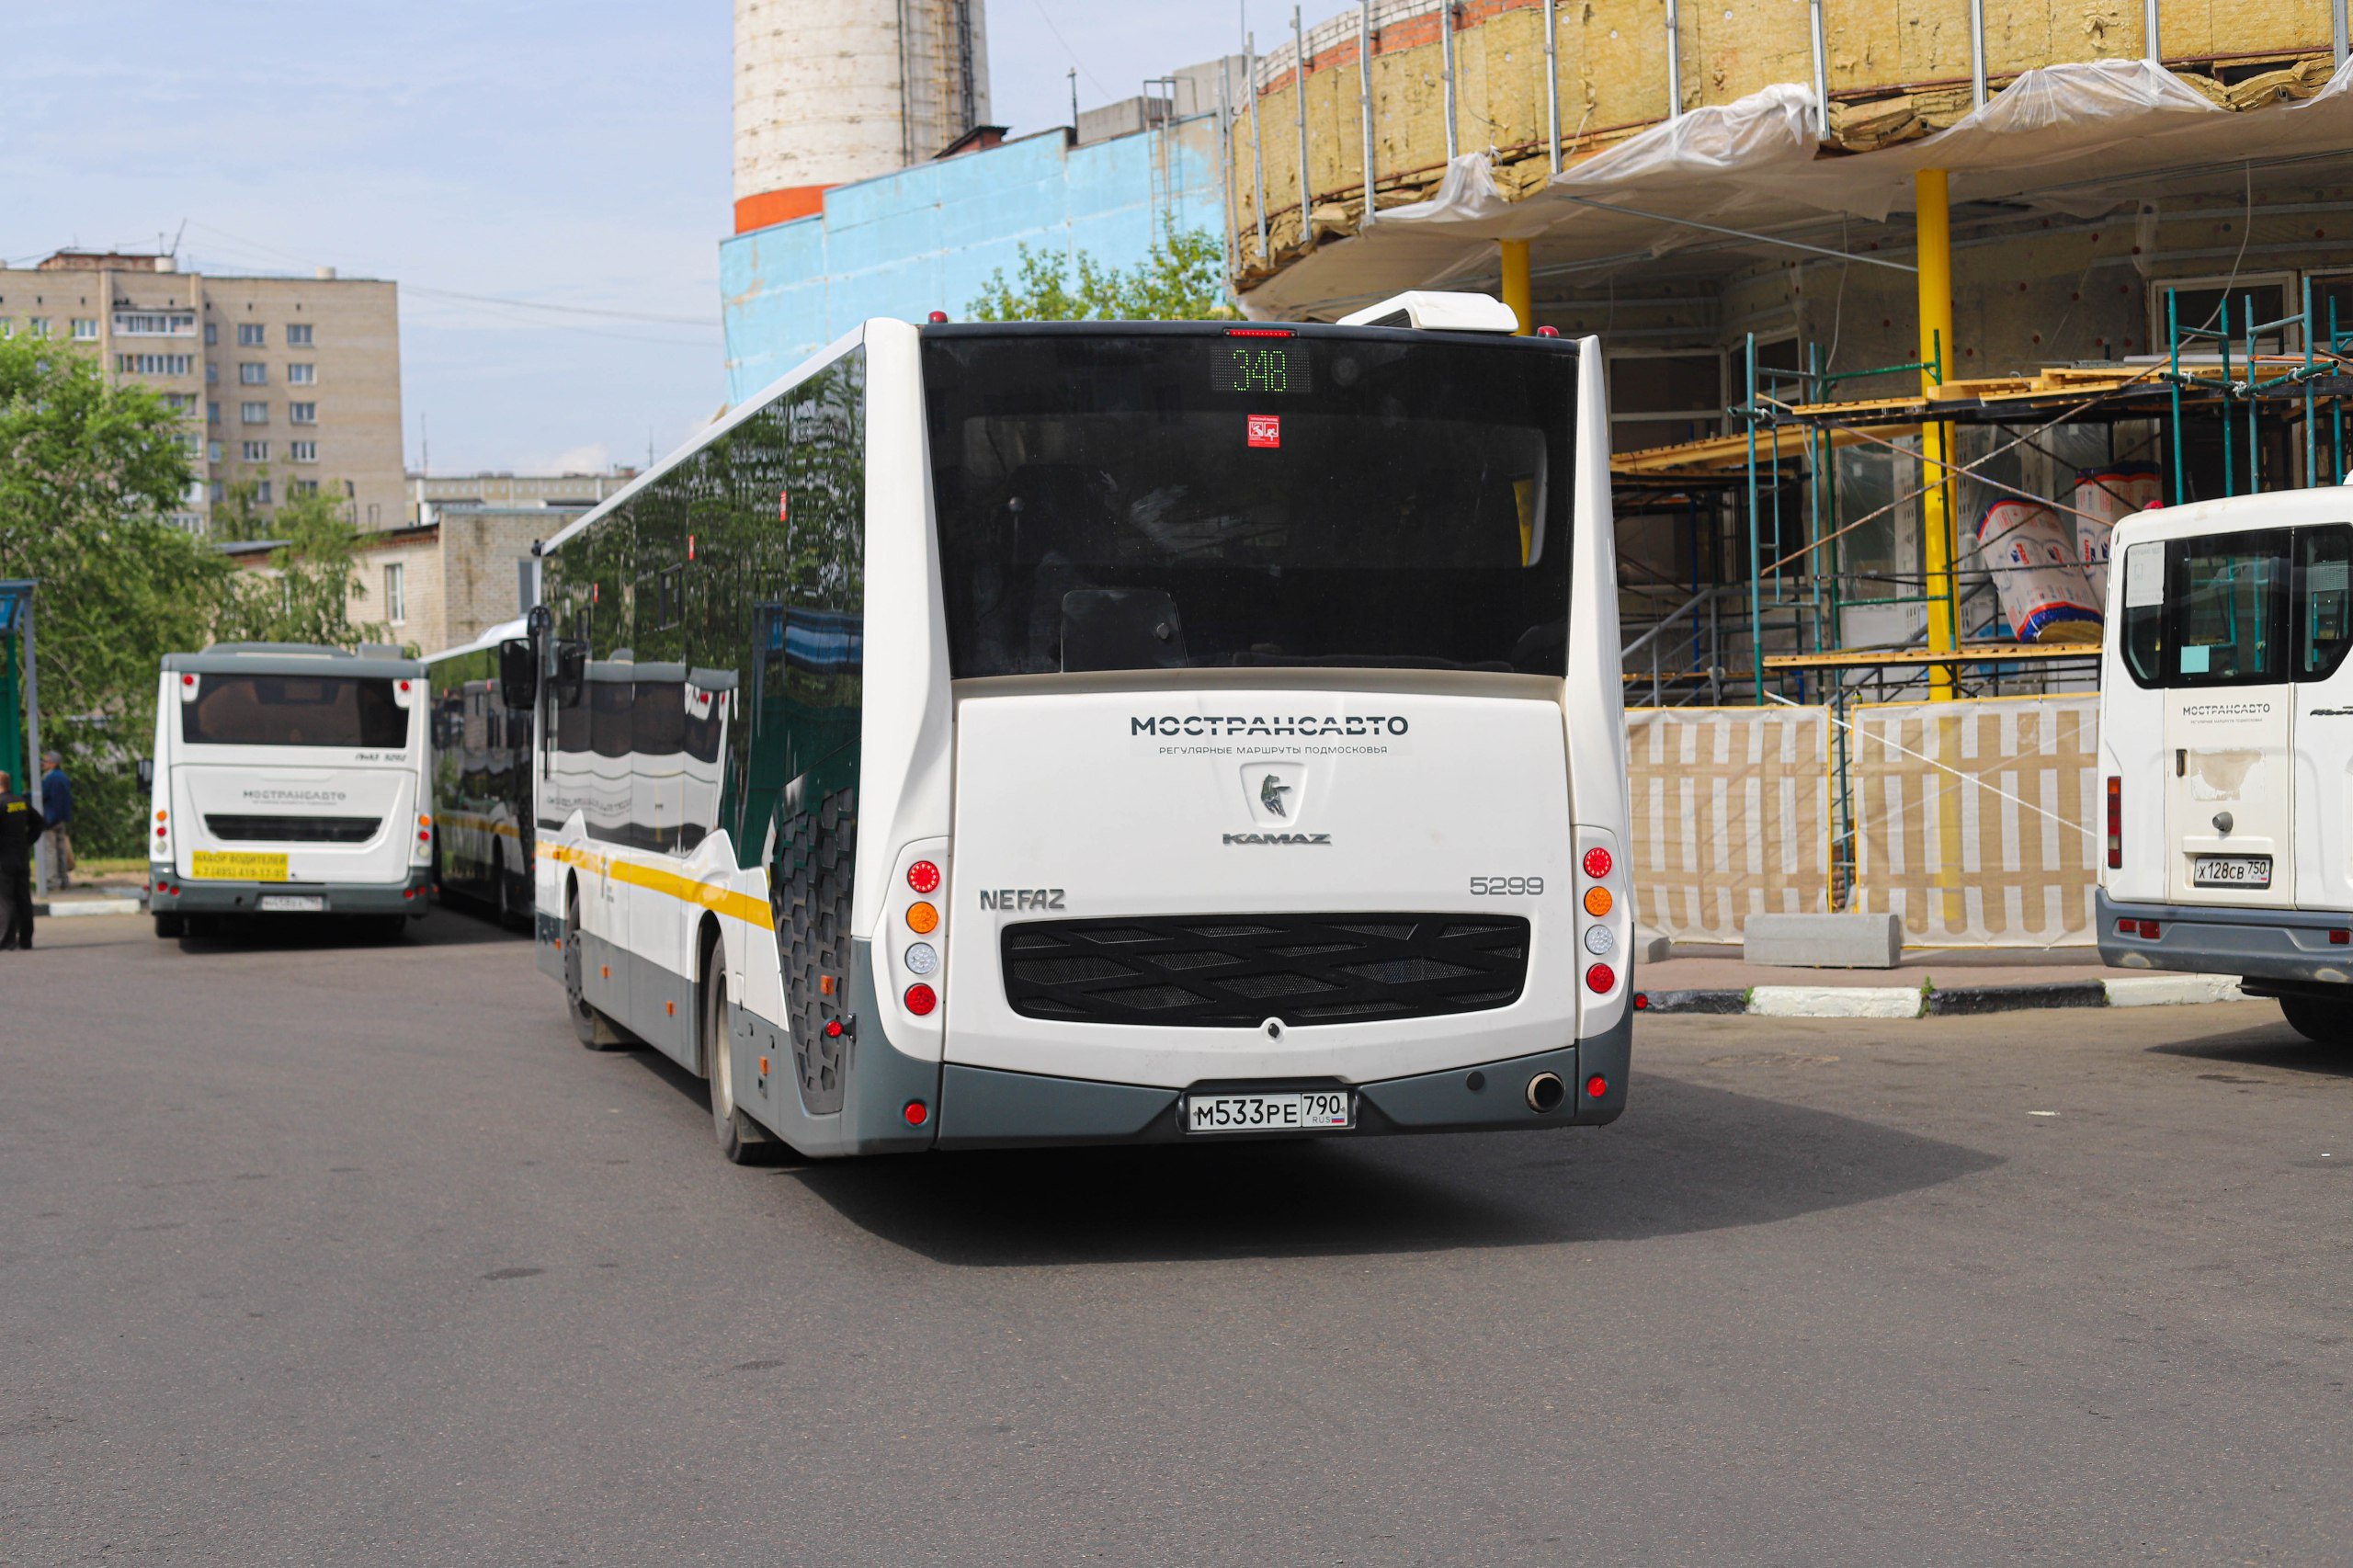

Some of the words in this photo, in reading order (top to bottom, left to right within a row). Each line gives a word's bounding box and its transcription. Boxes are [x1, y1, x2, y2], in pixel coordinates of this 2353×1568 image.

[1233, 349, 1286, 392] 348
[2183, 703, 2270, 716] МОСТРАНСАВТО
[1131, 716, 1409, 735] МОСТРАНСАВТО
[1159, 746, 1233, 755] РЕГУЛЯРНЫЕ
[1236, 746, 1302, 755] МАРШРУТЫ
[1304, 746, 1388, 755] ПОДМОСКОВЬЯ
[243, 790, 347, 801] МОСТРАНСАВТО
[1222, 834, 1332, 845] KAMAZ
[2247, 861, 2267, 875] 750
[1470, 876, 1544, 895] 5299
[980, 889, 1065, 910] NEFAZ
[1303, 1096, 1341, 1116] 790
[1313, 1116, 1331, 1124] RUS
